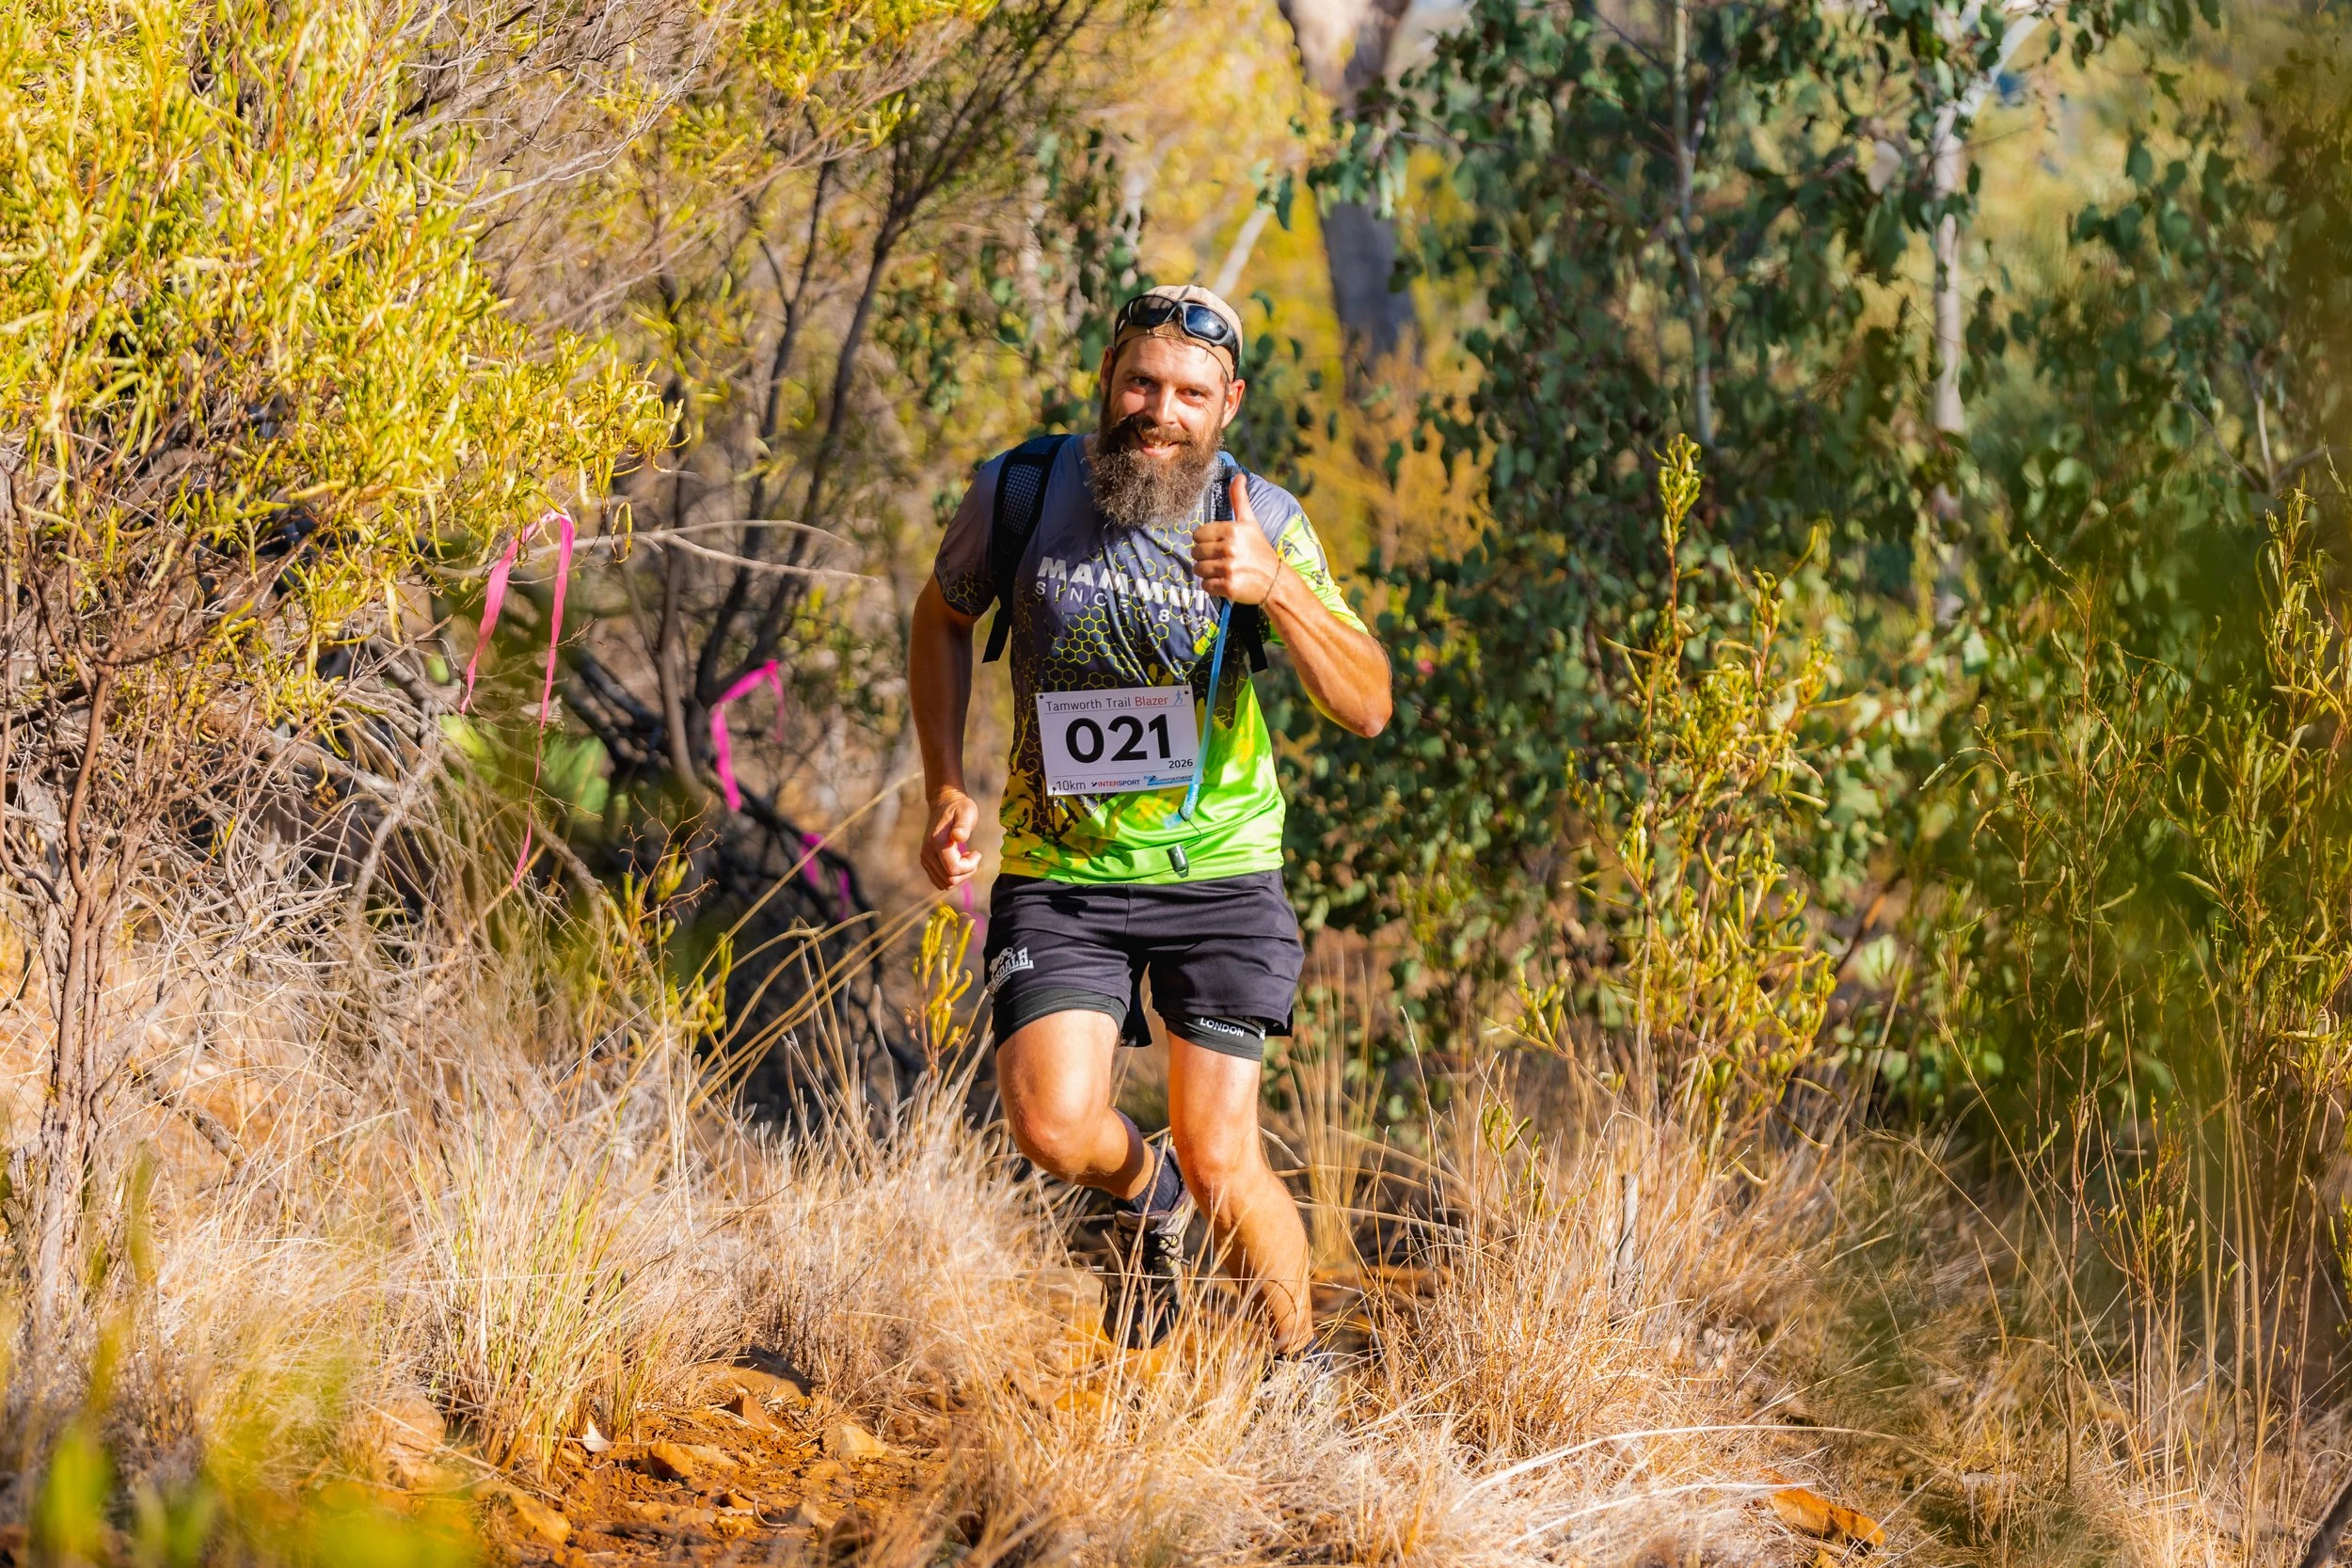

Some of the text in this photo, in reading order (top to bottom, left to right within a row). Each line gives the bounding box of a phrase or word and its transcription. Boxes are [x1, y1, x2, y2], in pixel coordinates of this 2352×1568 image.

[1035, 580, 1129, 613] SINCE
[1046, 696, 1168, 711] Tamworth Trail Blazer
[1065, 713, 1171, 764] 021
[1168, 759, 1194, 768] 2026
[1056, 780, 1087, 791] 10km
[1098, 779, 1140, 787] INTERSPORT
[1199, 1017, 1245, 1037] LONDON
